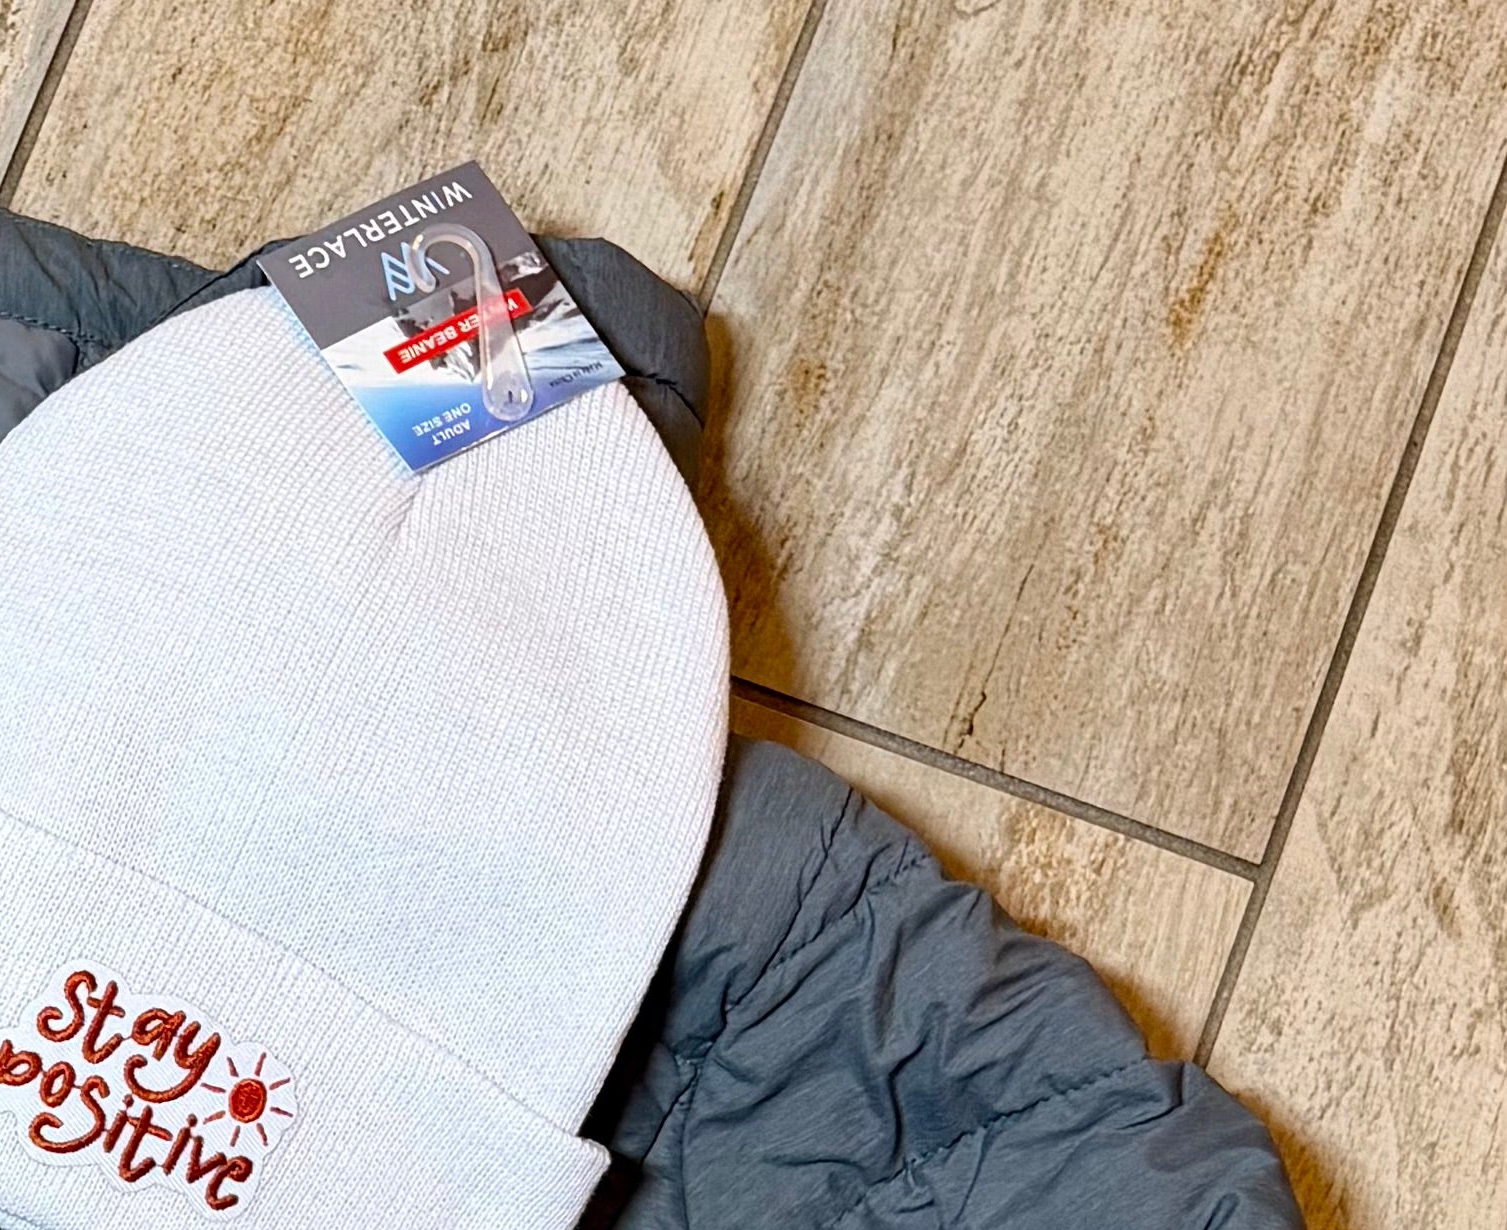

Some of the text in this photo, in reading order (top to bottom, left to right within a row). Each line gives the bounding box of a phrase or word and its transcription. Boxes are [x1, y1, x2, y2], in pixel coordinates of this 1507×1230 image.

[288, 181, 473, 279] WINTERLACE
[397, 297, 519, 364] WER BEANIE
[411, 402, 472, 437] ONE SIZE
[432, 418, 471, 446] ADULT
[36, 969, 222, 1104] Stay
